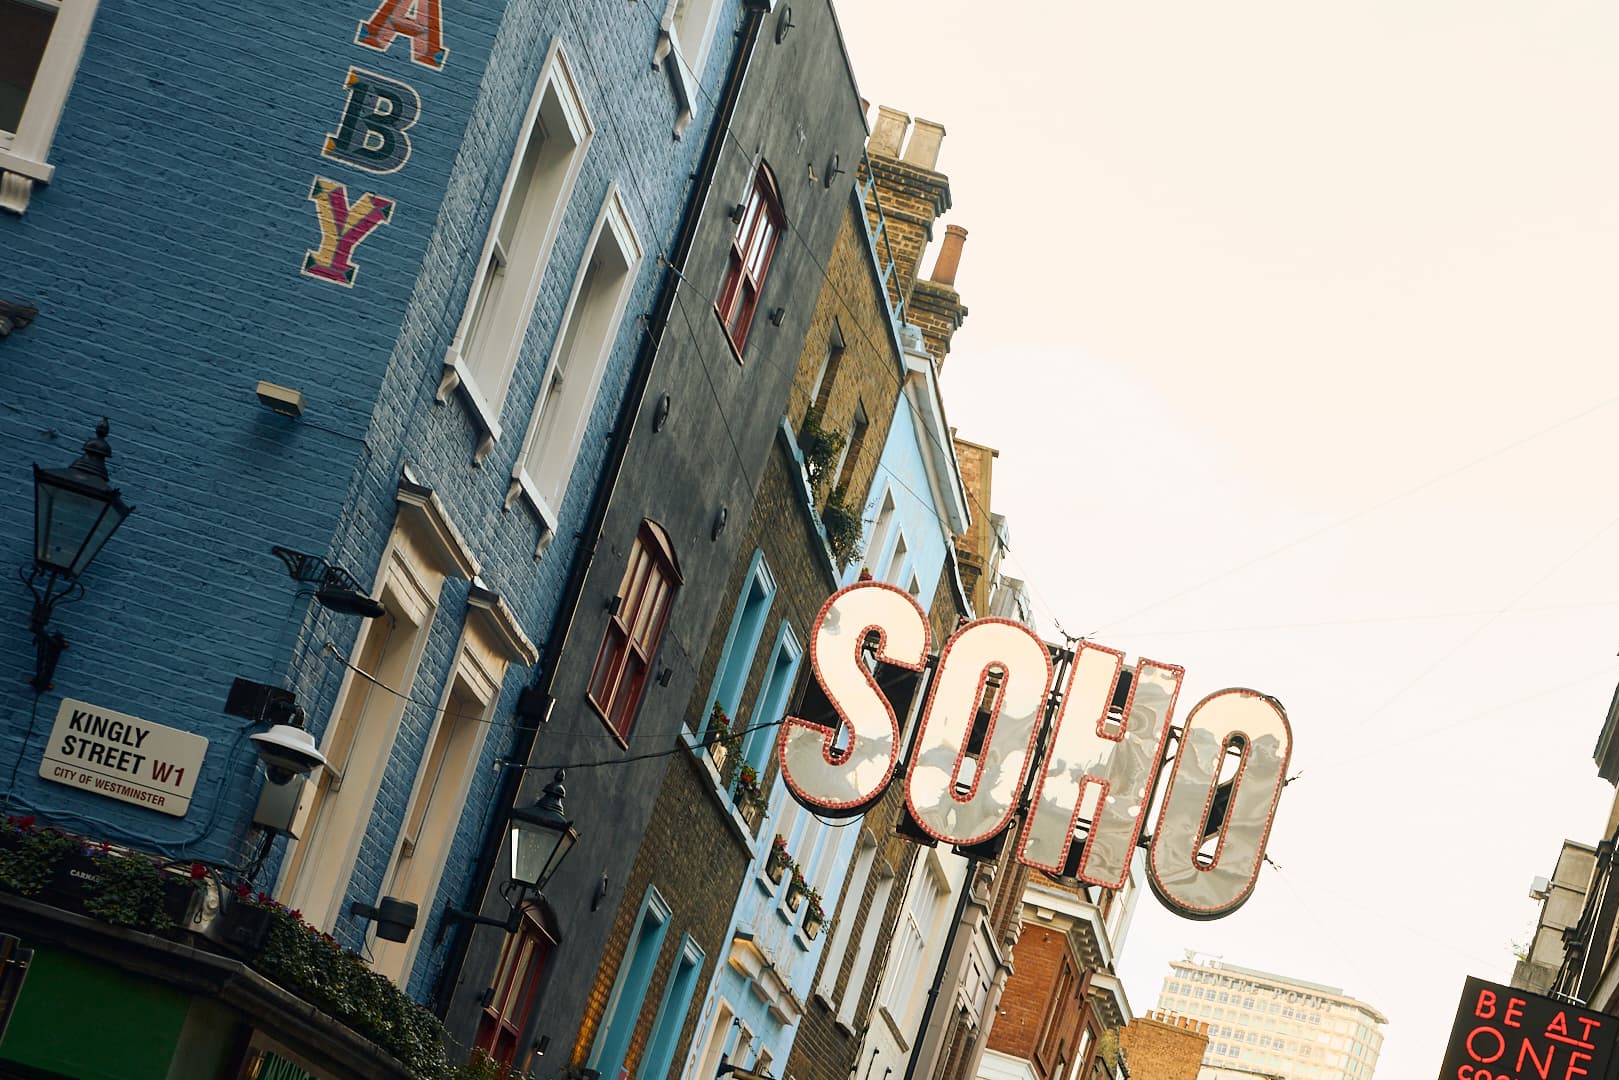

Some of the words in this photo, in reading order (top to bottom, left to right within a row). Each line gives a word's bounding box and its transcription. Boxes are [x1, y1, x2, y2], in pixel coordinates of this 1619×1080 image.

[69, 709, 150, 749] KINGLY
[779, 581, 1293, 919] SOHO
[61, 735, 146, 775] STREET
[151, 759, 185, 787] W1
[54, 766, 78, 781] CITY
[79, 773, 93, 785] OF
[95, 778, 166, 807] WESTMINSTER
[1190, 970, 1260, 996] CENTRE
[1272, 988, 1335, 1012] POINT
[1475, 989, 1527, 1028] BE
[1545, 1011, 1601, 1050] AT
